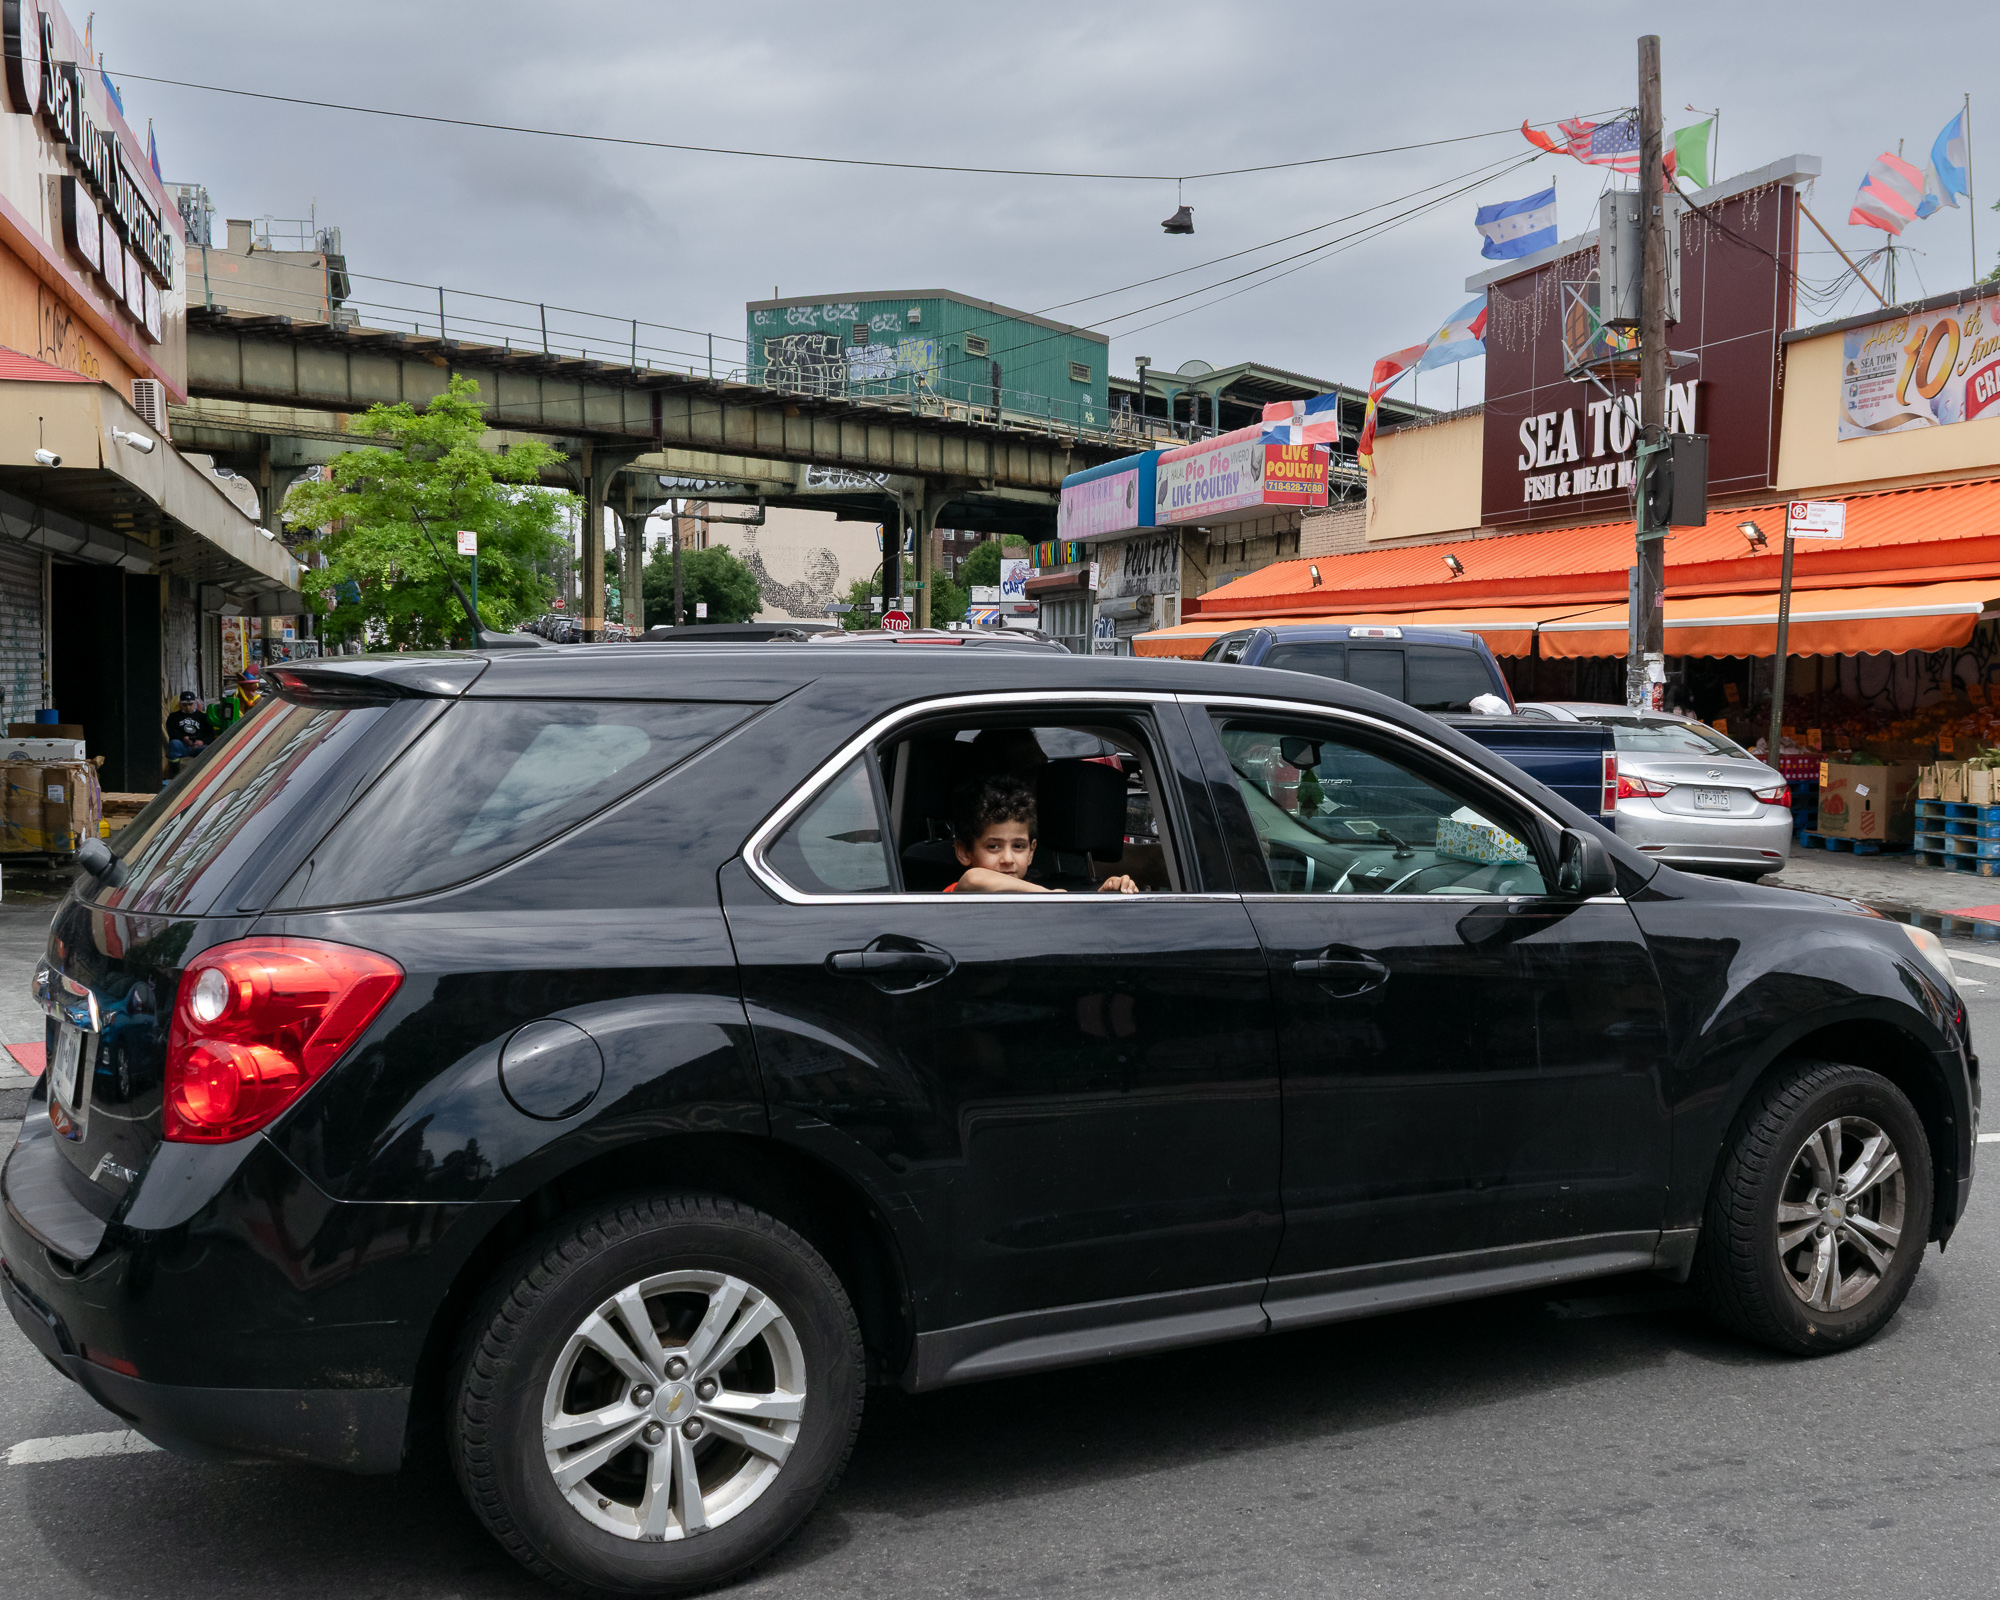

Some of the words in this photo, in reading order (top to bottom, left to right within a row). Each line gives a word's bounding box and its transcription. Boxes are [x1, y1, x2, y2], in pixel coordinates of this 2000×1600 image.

[45, 12, 74, 145] Sea
[75, 61, 110, 200] Town
[1864, 316, 1910, 356] Happy
[1860, 357, 1874, 369] SEA
[1876, 352, 1898, 366] TOWN
[1896, 318, 1960, 406] 10
[1964, 306, 1984, 338] th
[1518, 408, 1580, 472] SEA
[1588, 379, 1699, 458] TON
[1170, 466, 1184, 480] HALAL
[1185, 458, 1205, 482] Pio
[1209, 452, 1230, 476] Pio
[1230, 448, 1249, 464] VIVERO
[1282, 445, 1308, 461] LIVE
[1266, 461, 1323, 479] POULTRY
[1524, 473, 1556, 502] FISH
[1557, 471, 1571, 498] &
[1572, 462, 1616, 496] MEAT
[1172, 483, 1192, 508] LIVE
[1194, 470, 1240, 502] POULTRY
[1268, 482, 1322, 492] 718-628-7088
[1090, 498, 1123, 525] POULTRY
[1124, 535, 1179, 578] POULTRY
[1003, 581, 1019, 595] CAR
[884, 619, 908, 630] STOP
[1713, 794, 1728, 805] 3125
